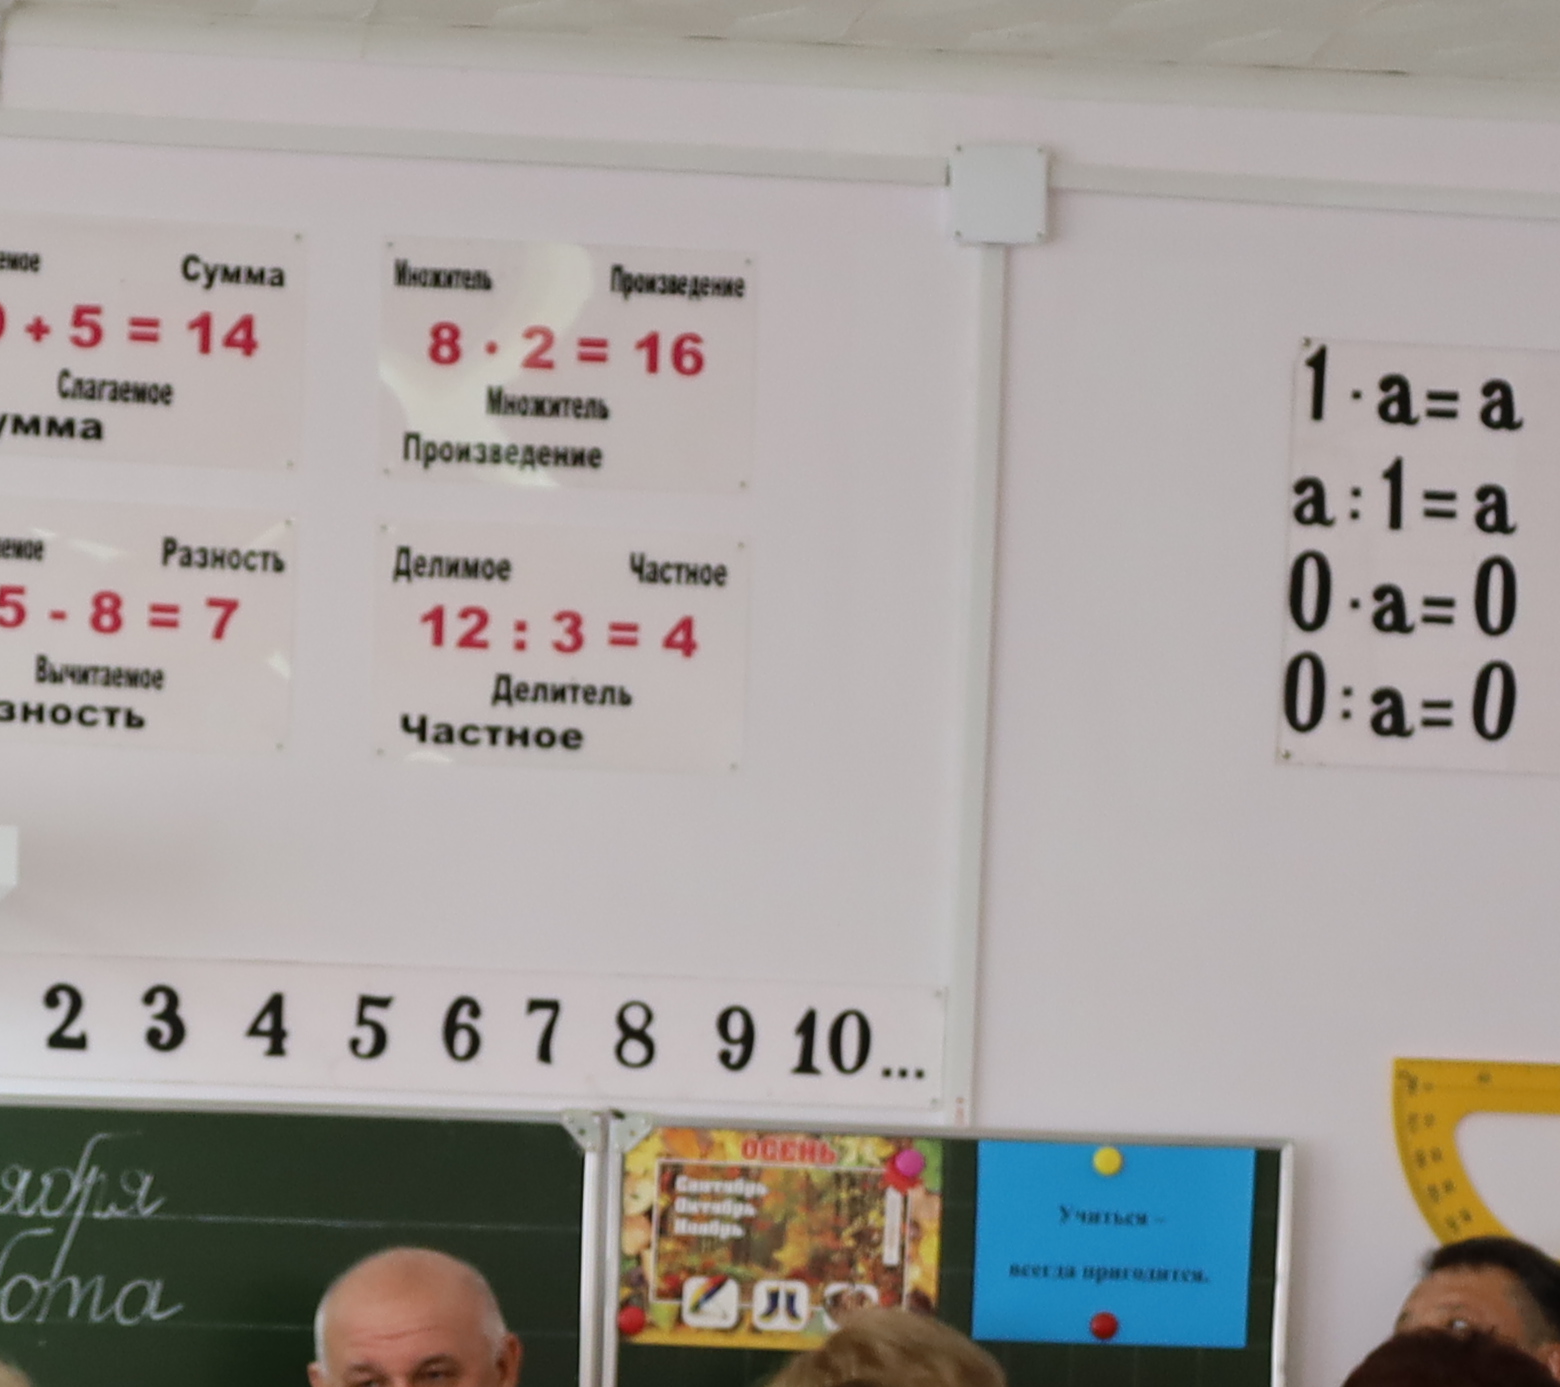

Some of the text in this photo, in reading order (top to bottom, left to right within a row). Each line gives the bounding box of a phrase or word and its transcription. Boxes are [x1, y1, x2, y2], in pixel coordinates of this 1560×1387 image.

[181, 253, 286, 289] Сумма
[394, 258, 745, 304] Множитель Произведение
[69, 305, 104, 349] 5
[186, 311, 259, 358] 14
[428, 321, 463, 365] 8
[521, 325, 556, 370] 2
[634, 330, 706, 377] 16
[57, 368, 173, 405] Слагаемое
[486, 385, 610, 421] Множитель
[403, 431, 602, 470] Произведение
[161, 536, 287, 574] Разность
[393, 545, 728, 587] Делимое Частное
[89, 590, 123, 634] 8
[205, 597, 240, 641] 7
[420, 604, 491, 650] 12
[551, 610, 584, 654] 3
[662, 615, 698, 658] 4
[35, 655, 165, 691] Вычитаемое
[491, 673, 633, 707] Делитель
[400, 713, 584, 750] Частное
[44, 982, 88, 1050] 2
[142, 984, 186, 1052] 3
[245, 992, 288, 1057] 4
[349, 996, 394, 1059] 5
[442, 997, 480, 1062] 6
[525, 998, 561, 1064] 7
[613, 1001, 655, 1069] 8
[716, 1005, 756, 1072] 9
[741, 1137, 837, 1164] ОСЕНЬ
[1059, 1204, 1149, 1226] Учиться
[1009, 1263, 1076, 1278] всегда
